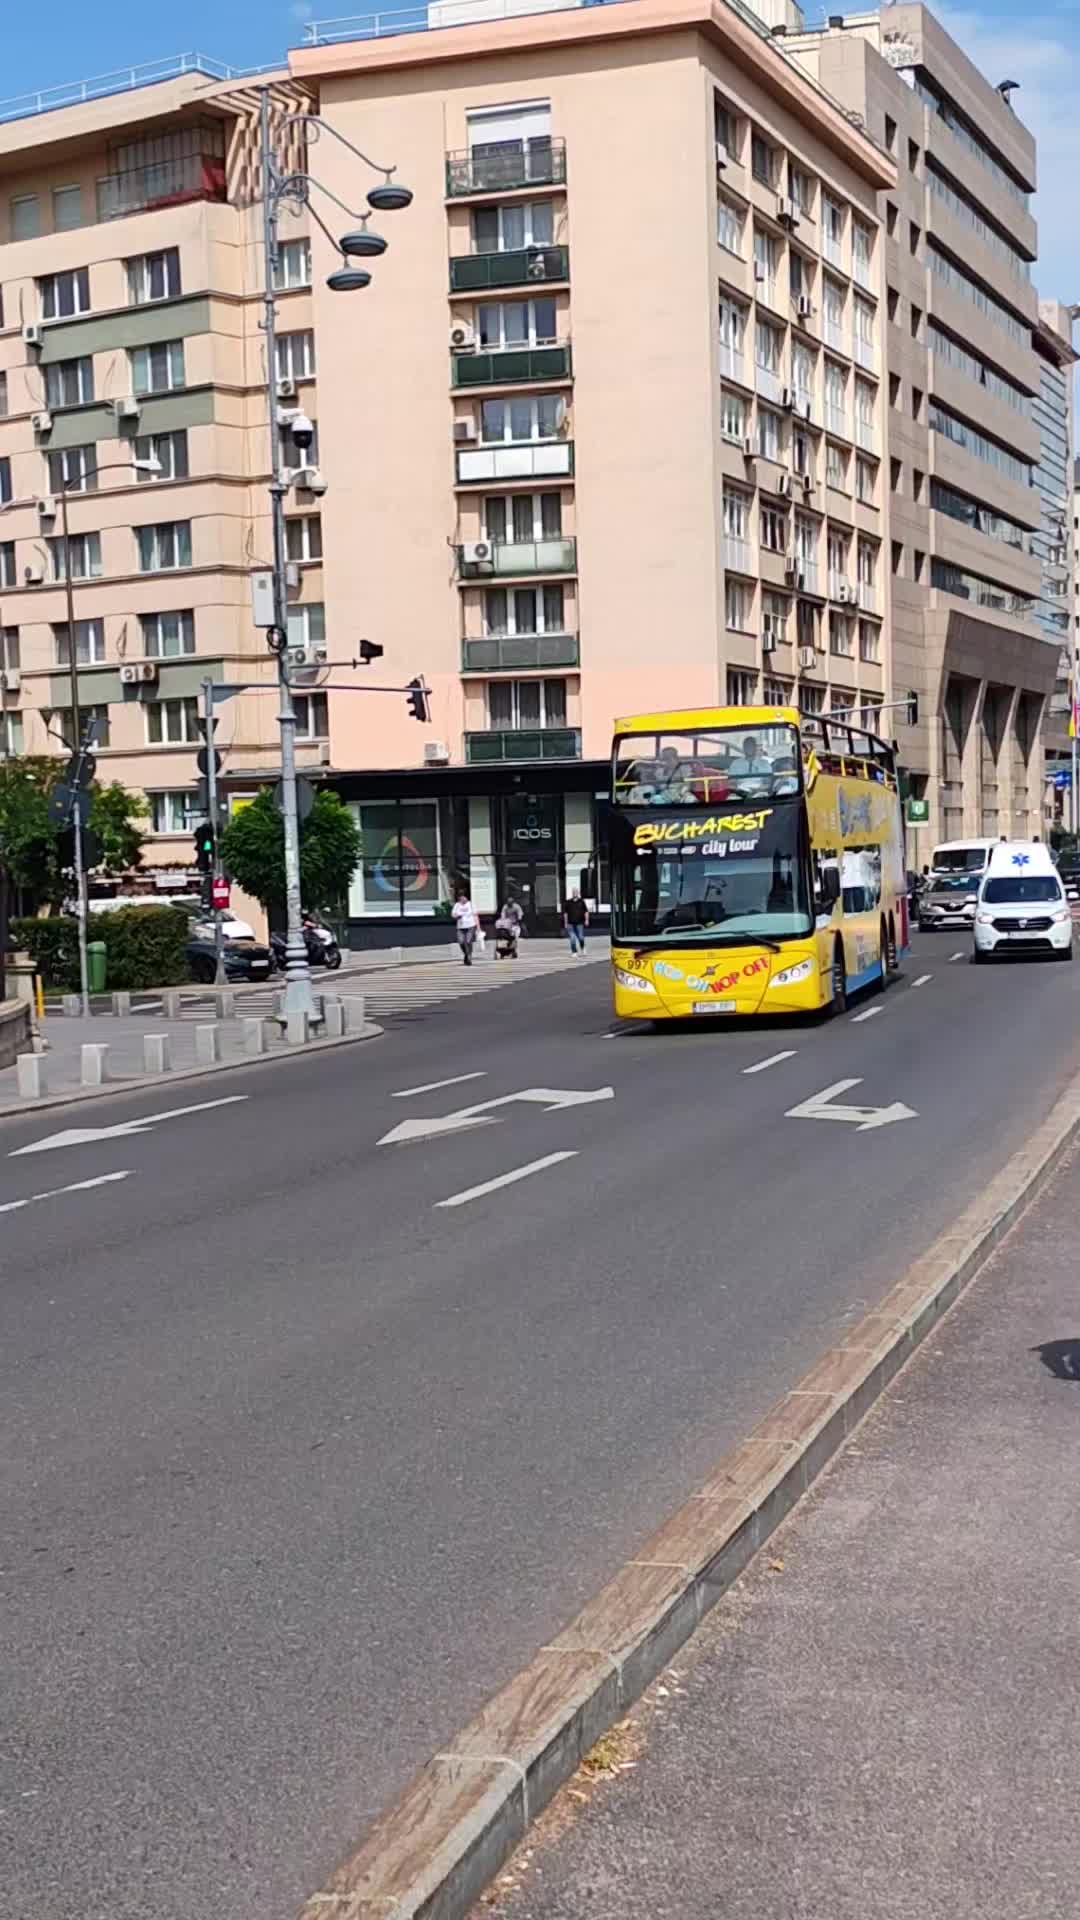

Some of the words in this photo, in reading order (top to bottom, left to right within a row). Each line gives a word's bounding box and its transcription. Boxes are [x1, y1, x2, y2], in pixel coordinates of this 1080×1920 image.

[513, 828, 552, 840] IQOS
[634, 808, 774, 846] BUCHAREST
[701, 840, 728, 858] city
[729, 839, 759, 853] tour
[627, 959, 649, 970] 997
[711, 971, 740, 994] HOP
